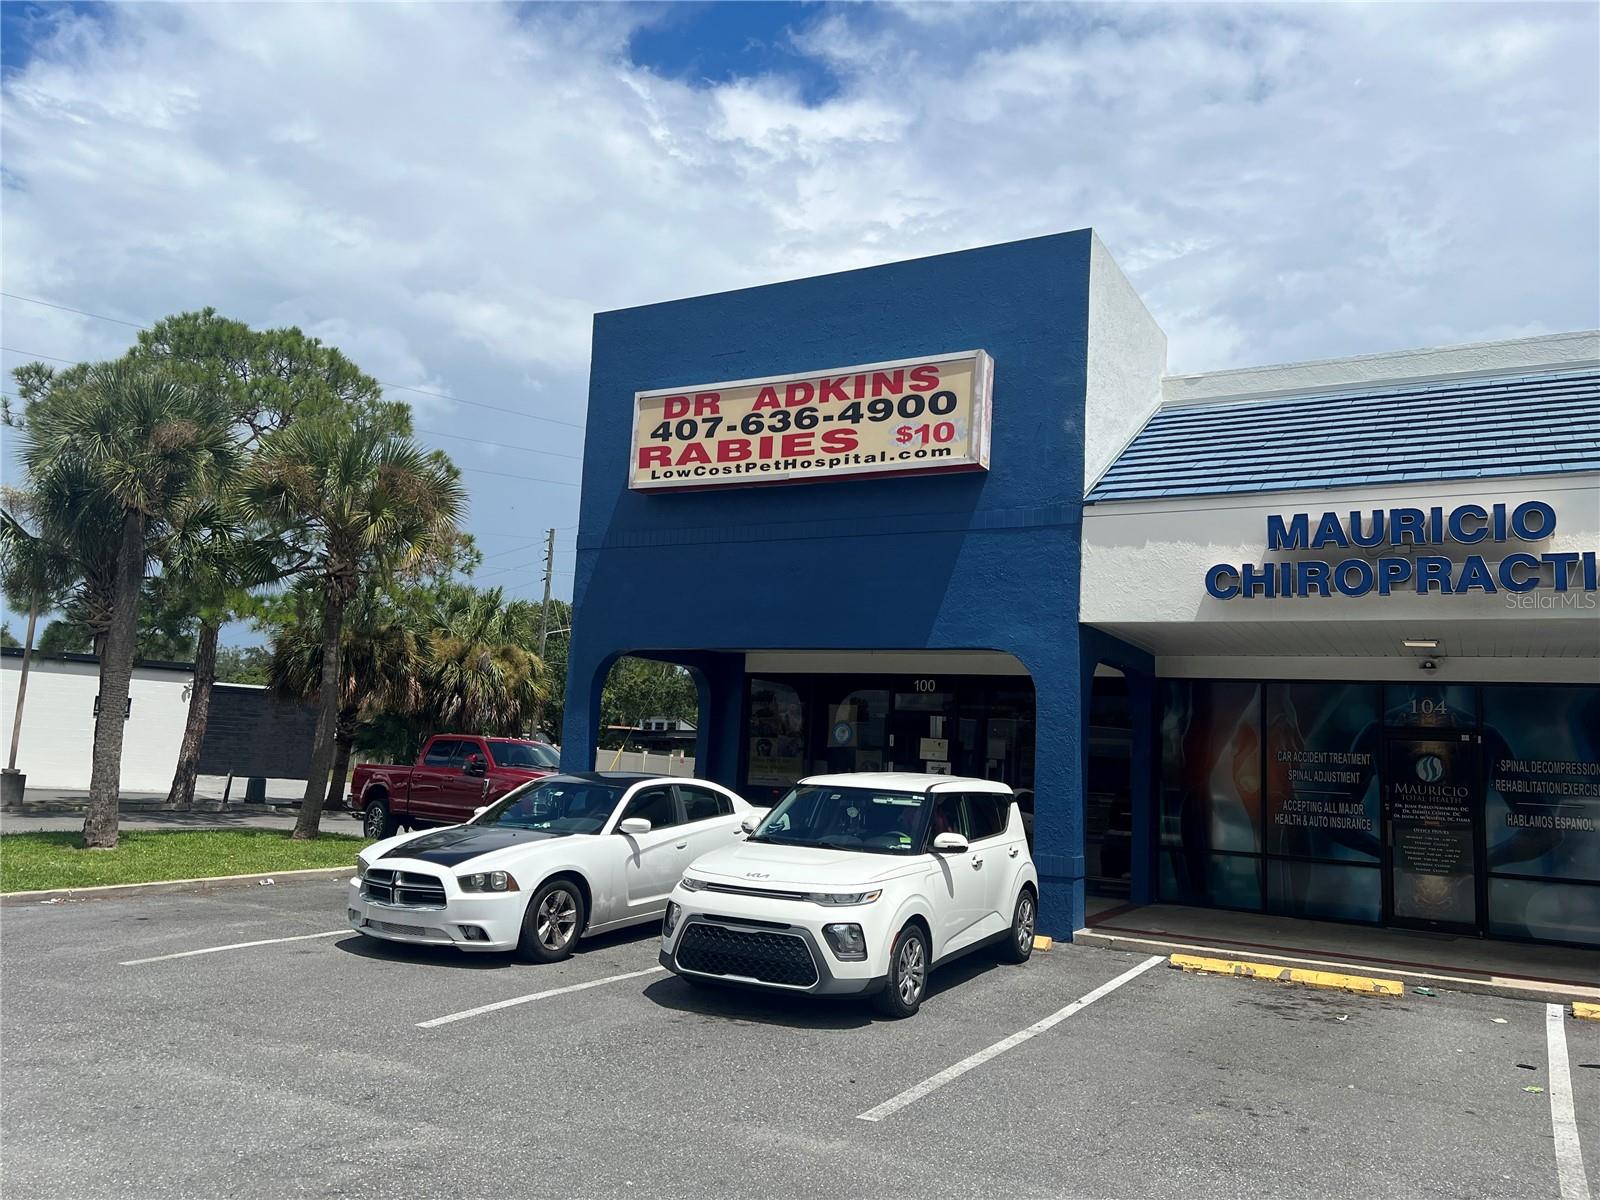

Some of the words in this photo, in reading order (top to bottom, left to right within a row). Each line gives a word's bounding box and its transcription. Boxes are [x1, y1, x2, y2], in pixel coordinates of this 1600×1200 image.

[663, 392, 721, 420] DR
[752, 365, 941, 411] ADKINS
[650, 391, 958, 442] 407-636-4900
[638, 428, 860, 469] RABIES
[896, 421, 955, 447] $10
[651, 446, 952, 480] LowCostPetHospital.com
[1266, 500, 1557, 551] MAURICIO
[1205, 552, 1598, 600] CHIROPRACTI
[913, 679, 936, 692] 100
[1410, 699, 1448, 715] 104
[1277, 751, 1292, 762] CAR
[1293, 751, 1328, 764] ACCIDENT
[1329, 752, 1371, 765] TREATMENT
[1500, 759, 1530, 773] SPINAL
[1288, 769, 1312, 782] SPINAL
[1313, 770, 1360, 784] ADJUSTMENT
[1394, 783, 1469, 798] MAURICIO
[1402, 794, 1425, 802] TOTAL
[1429, 795, 1462, 804] HEALTH
[1282, 799, 1323, 813] ACCEPTING
[1323, 801, 1338, 814] ALL
[1338, 802, 1364, 815] MAJOR
[1274, 813, 1301, 825] HEALTH
[1302, 814, 1308, 826] &
[1308, 815, 1328, 828] AUTO
[1329, 816, 1371, 831] INSURANCE
[1507, 813, 1553, 829] HABLAMOS
[1554, 815, 1595, 832] ESPAÑOL
